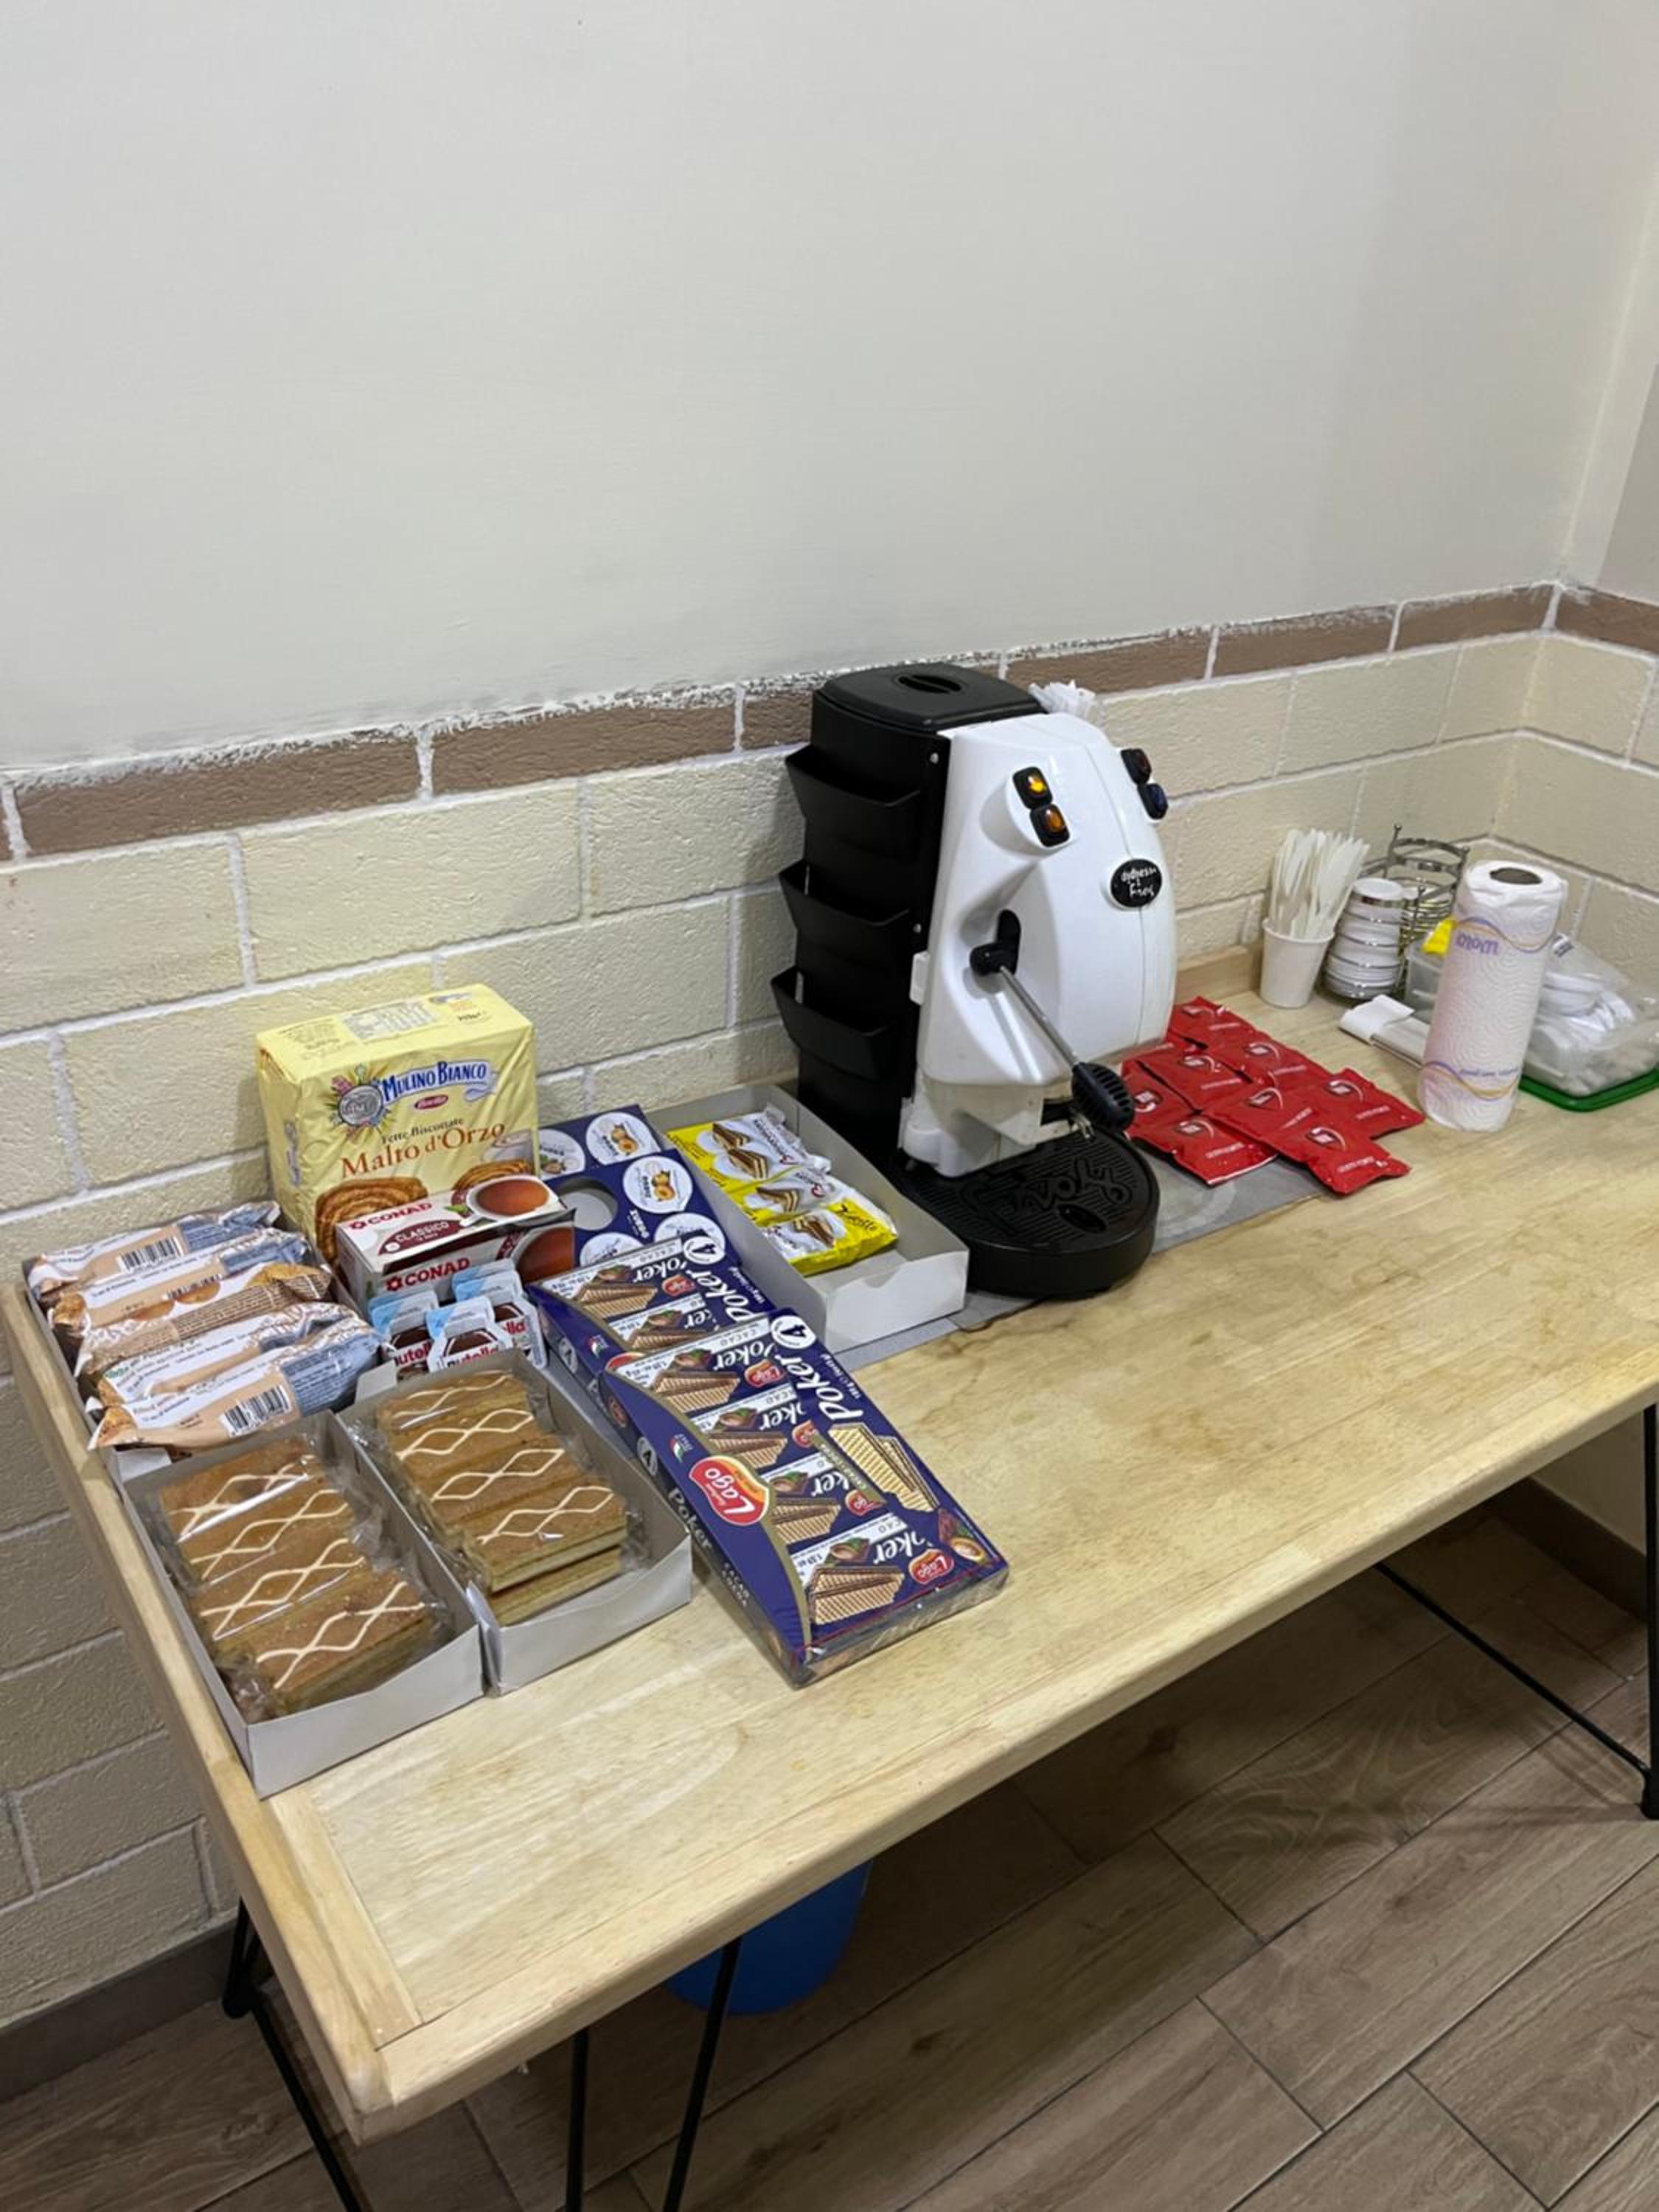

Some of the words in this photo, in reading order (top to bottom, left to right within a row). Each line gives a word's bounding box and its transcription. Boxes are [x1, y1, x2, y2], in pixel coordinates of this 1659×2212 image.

[382, 1071, 436, 1102] MULINO
[437, 1061, 487, 1085] BIANCO
[341, 1144, 420, 1178] Malto
[425, 1123, 505, 1153] d'Orzo
[367, 1203, 432, 1225] CONAD
[396, 1221, 449, 1242] CLASSICO
[692, 1242, 717, 1255] 4
[404, 1257, 470, 1286] CONAD
[685, 1270, 757, 1323] Poker
[779, 1324, 808, 1338] 4
[774, 1354, 863, 1420] Poker
[705, 1468, 756, 1514] Lago
[667, 1487, 713, 1549] Poker
[918, 1556, 948, 1578] Lago
